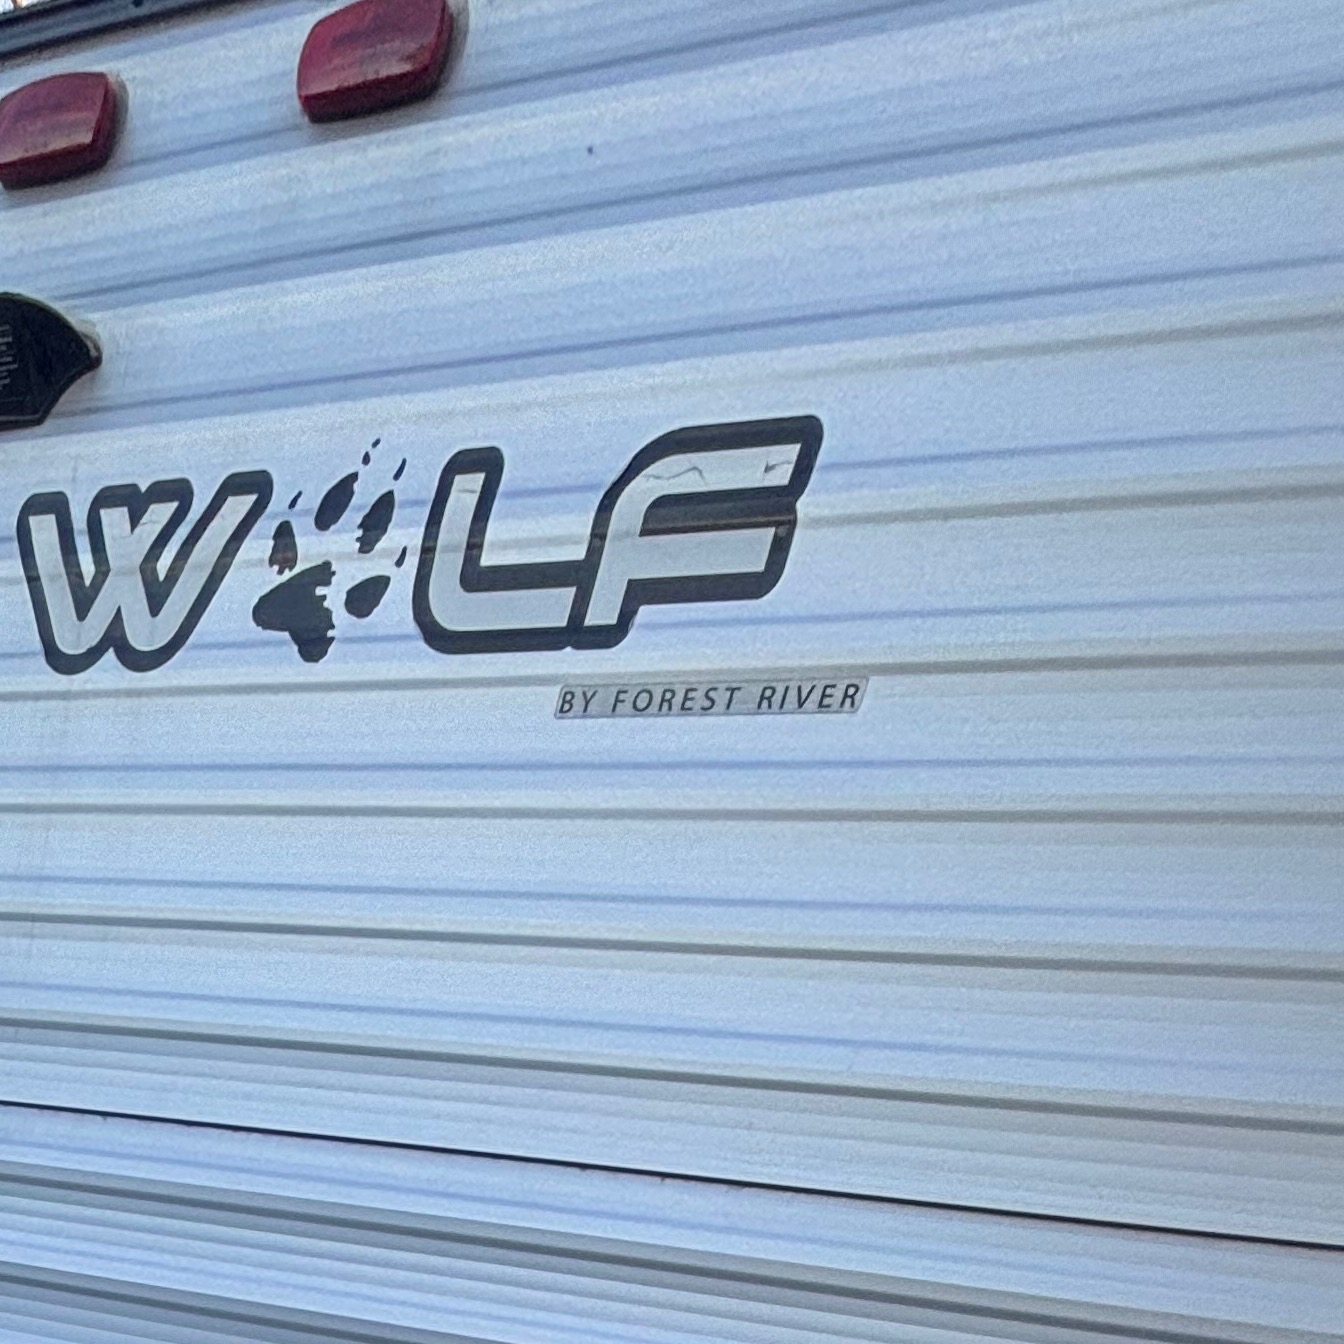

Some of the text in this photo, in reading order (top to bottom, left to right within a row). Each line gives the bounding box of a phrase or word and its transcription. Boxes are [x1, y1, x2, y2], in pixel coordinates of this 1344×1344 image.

[558, 683, 862, 714] BY FOREST RIVER
